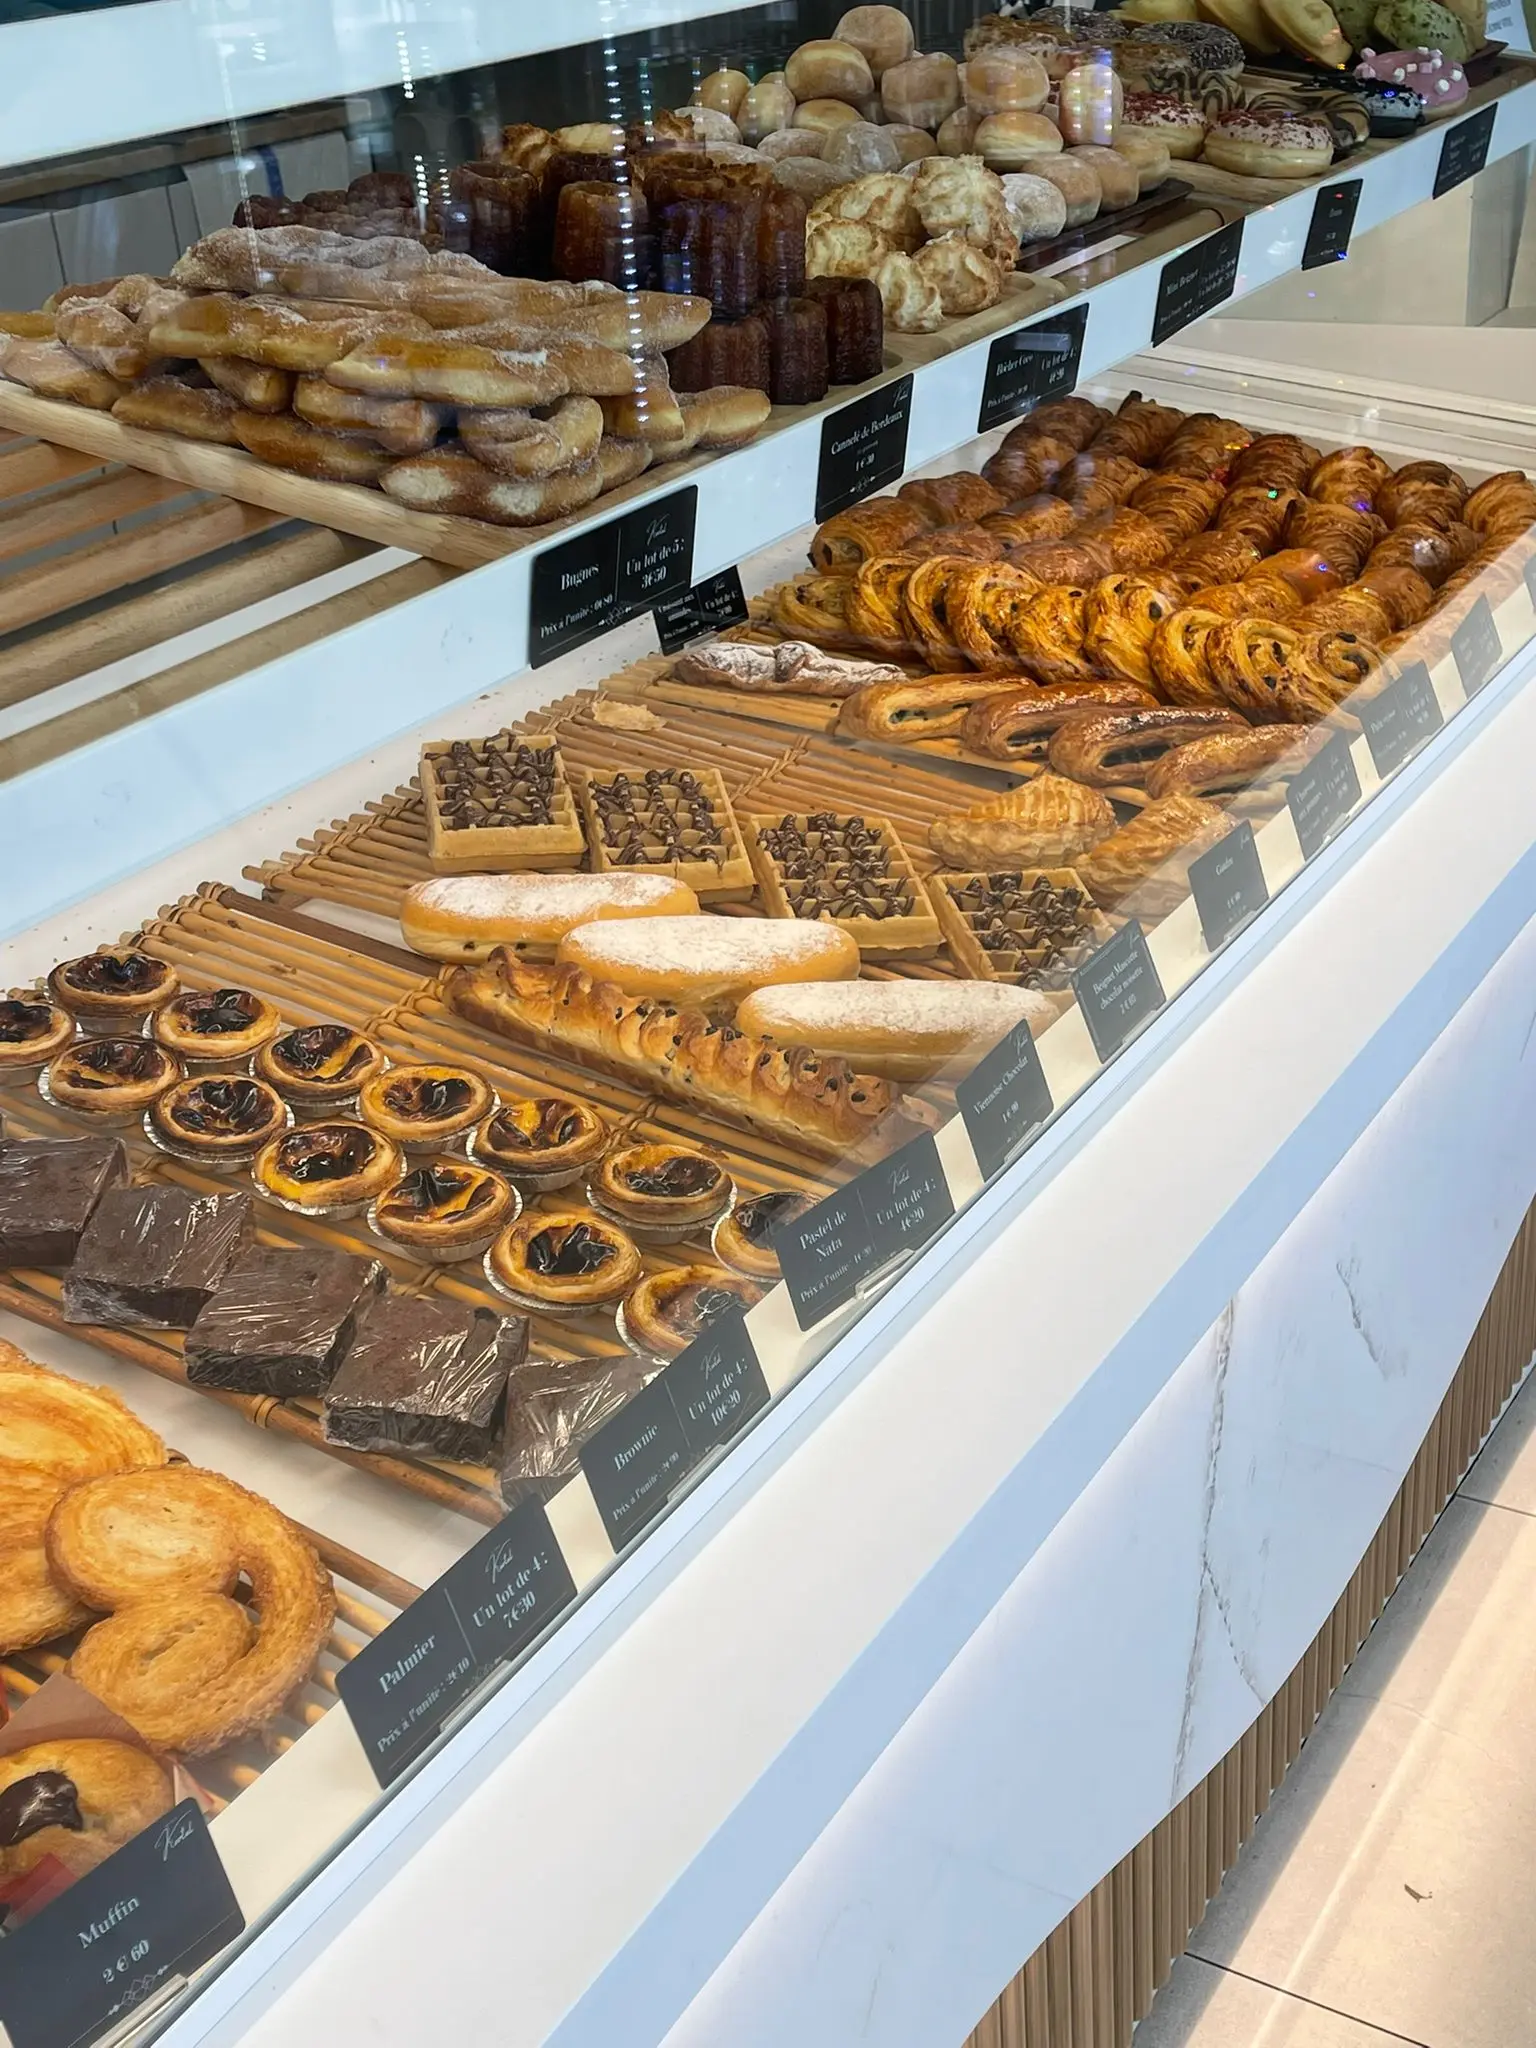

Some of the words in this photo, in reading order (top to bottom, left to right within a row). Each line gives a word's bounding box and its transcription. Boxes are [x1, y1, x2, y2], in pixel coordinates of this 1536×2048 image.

[861, 426, 870, 439] de
[871, 410, 903, 434] Bordeaux
[626, 559, 641, 576] Un
[644, 552, 657, 568] lot
[659, 546, 671, 561] de
[673, 539, 680, 554] 5
[641, 566, 667, 588] 3€50
[561, 564, 599, 591] Bugnes
[541, 623, 557, 639] Prix
[877, 1208, 894, 1225] Un
[895, 1197, 909, 1214] lot
[910, 1189, 922, 1203] de
[924, 1180, 930, 1193] 4
[800, 1217, 833, 1250] Pastel
[834, 1210, 847, 1226] de
[816, 1238, 842, 1262] Nata
[800, 1286, 818, 1302] Prix
[689, 1401, 706, 1420] Un
[706, 1384, 721, 1404] lot
[722, 1371, 734, 1389] de
[735, 1361, 742, 1374] 4
[614, 1424, 658, 1472] Brownie
[612, 1503, 631, 1521] Prix
[473, 1605, 496, 1628] Un
[496, 1584, 516, 1607] lot
[516, 1569, 530, 1589] de
[533, 1555, 541, 1572] 4
[503, 1591, 536, 1629] 7€30
[379, 1635, 435, 1694] Palmier
[376, 1729, 402, 1753] Prix
[401, 1717, 410, 1732] à
[408, 1685, 441, 1723] l'unité
[446, 1657, 471, 1686] 2€10
[76, 1895, 141, 1950] Muffin
[102, 1967, 114, 1985] 2
[116, 1955, 130, 1974] €
[130, 1938, 150, 1963] 60
